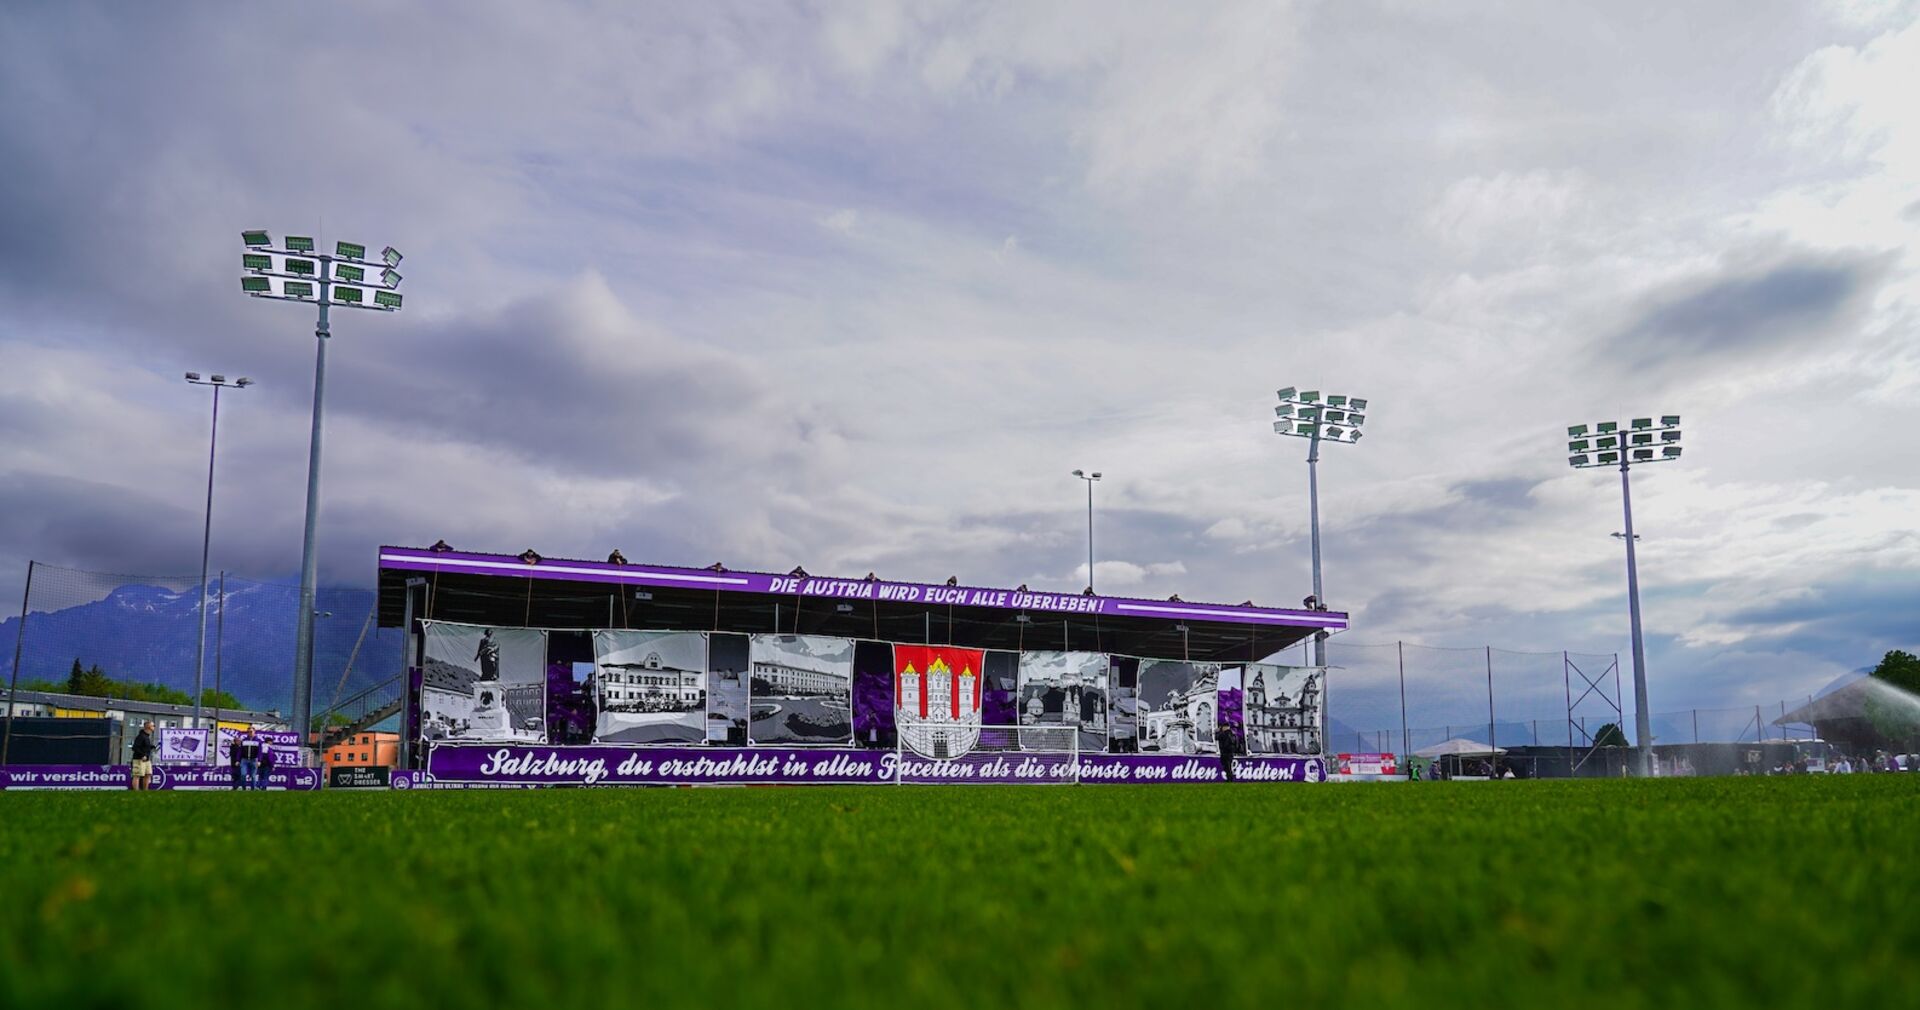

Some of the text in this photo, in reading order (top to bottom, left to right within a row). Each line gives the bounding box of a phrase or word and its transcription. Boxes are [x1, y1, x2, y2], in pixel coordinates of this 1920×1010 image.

[769, 577, 1105, 612] DIE AUSTRIA WIRD EUCH ALLE ÜBERLEBEN!
[10, 771, 127, 781] wir versichern
[173, 771, 199, 782] wir
[480, 748, 609, 784] Salzburg,
[617, 752, 653, 776] du
[658, 753, 780, 777] erstrahlst
[782, 753, 809, 776] in
[813, 754, 873, 777] allen
[877, 752, 976, 780] Facetten
[979, 756, 1011, 778] als
[1014, 757, 1047, 778] die
[1049, 758, 1131, 780] schönste
[1134, 762, 1168, 779] von
[1171, 760, 1218, 780] allen
